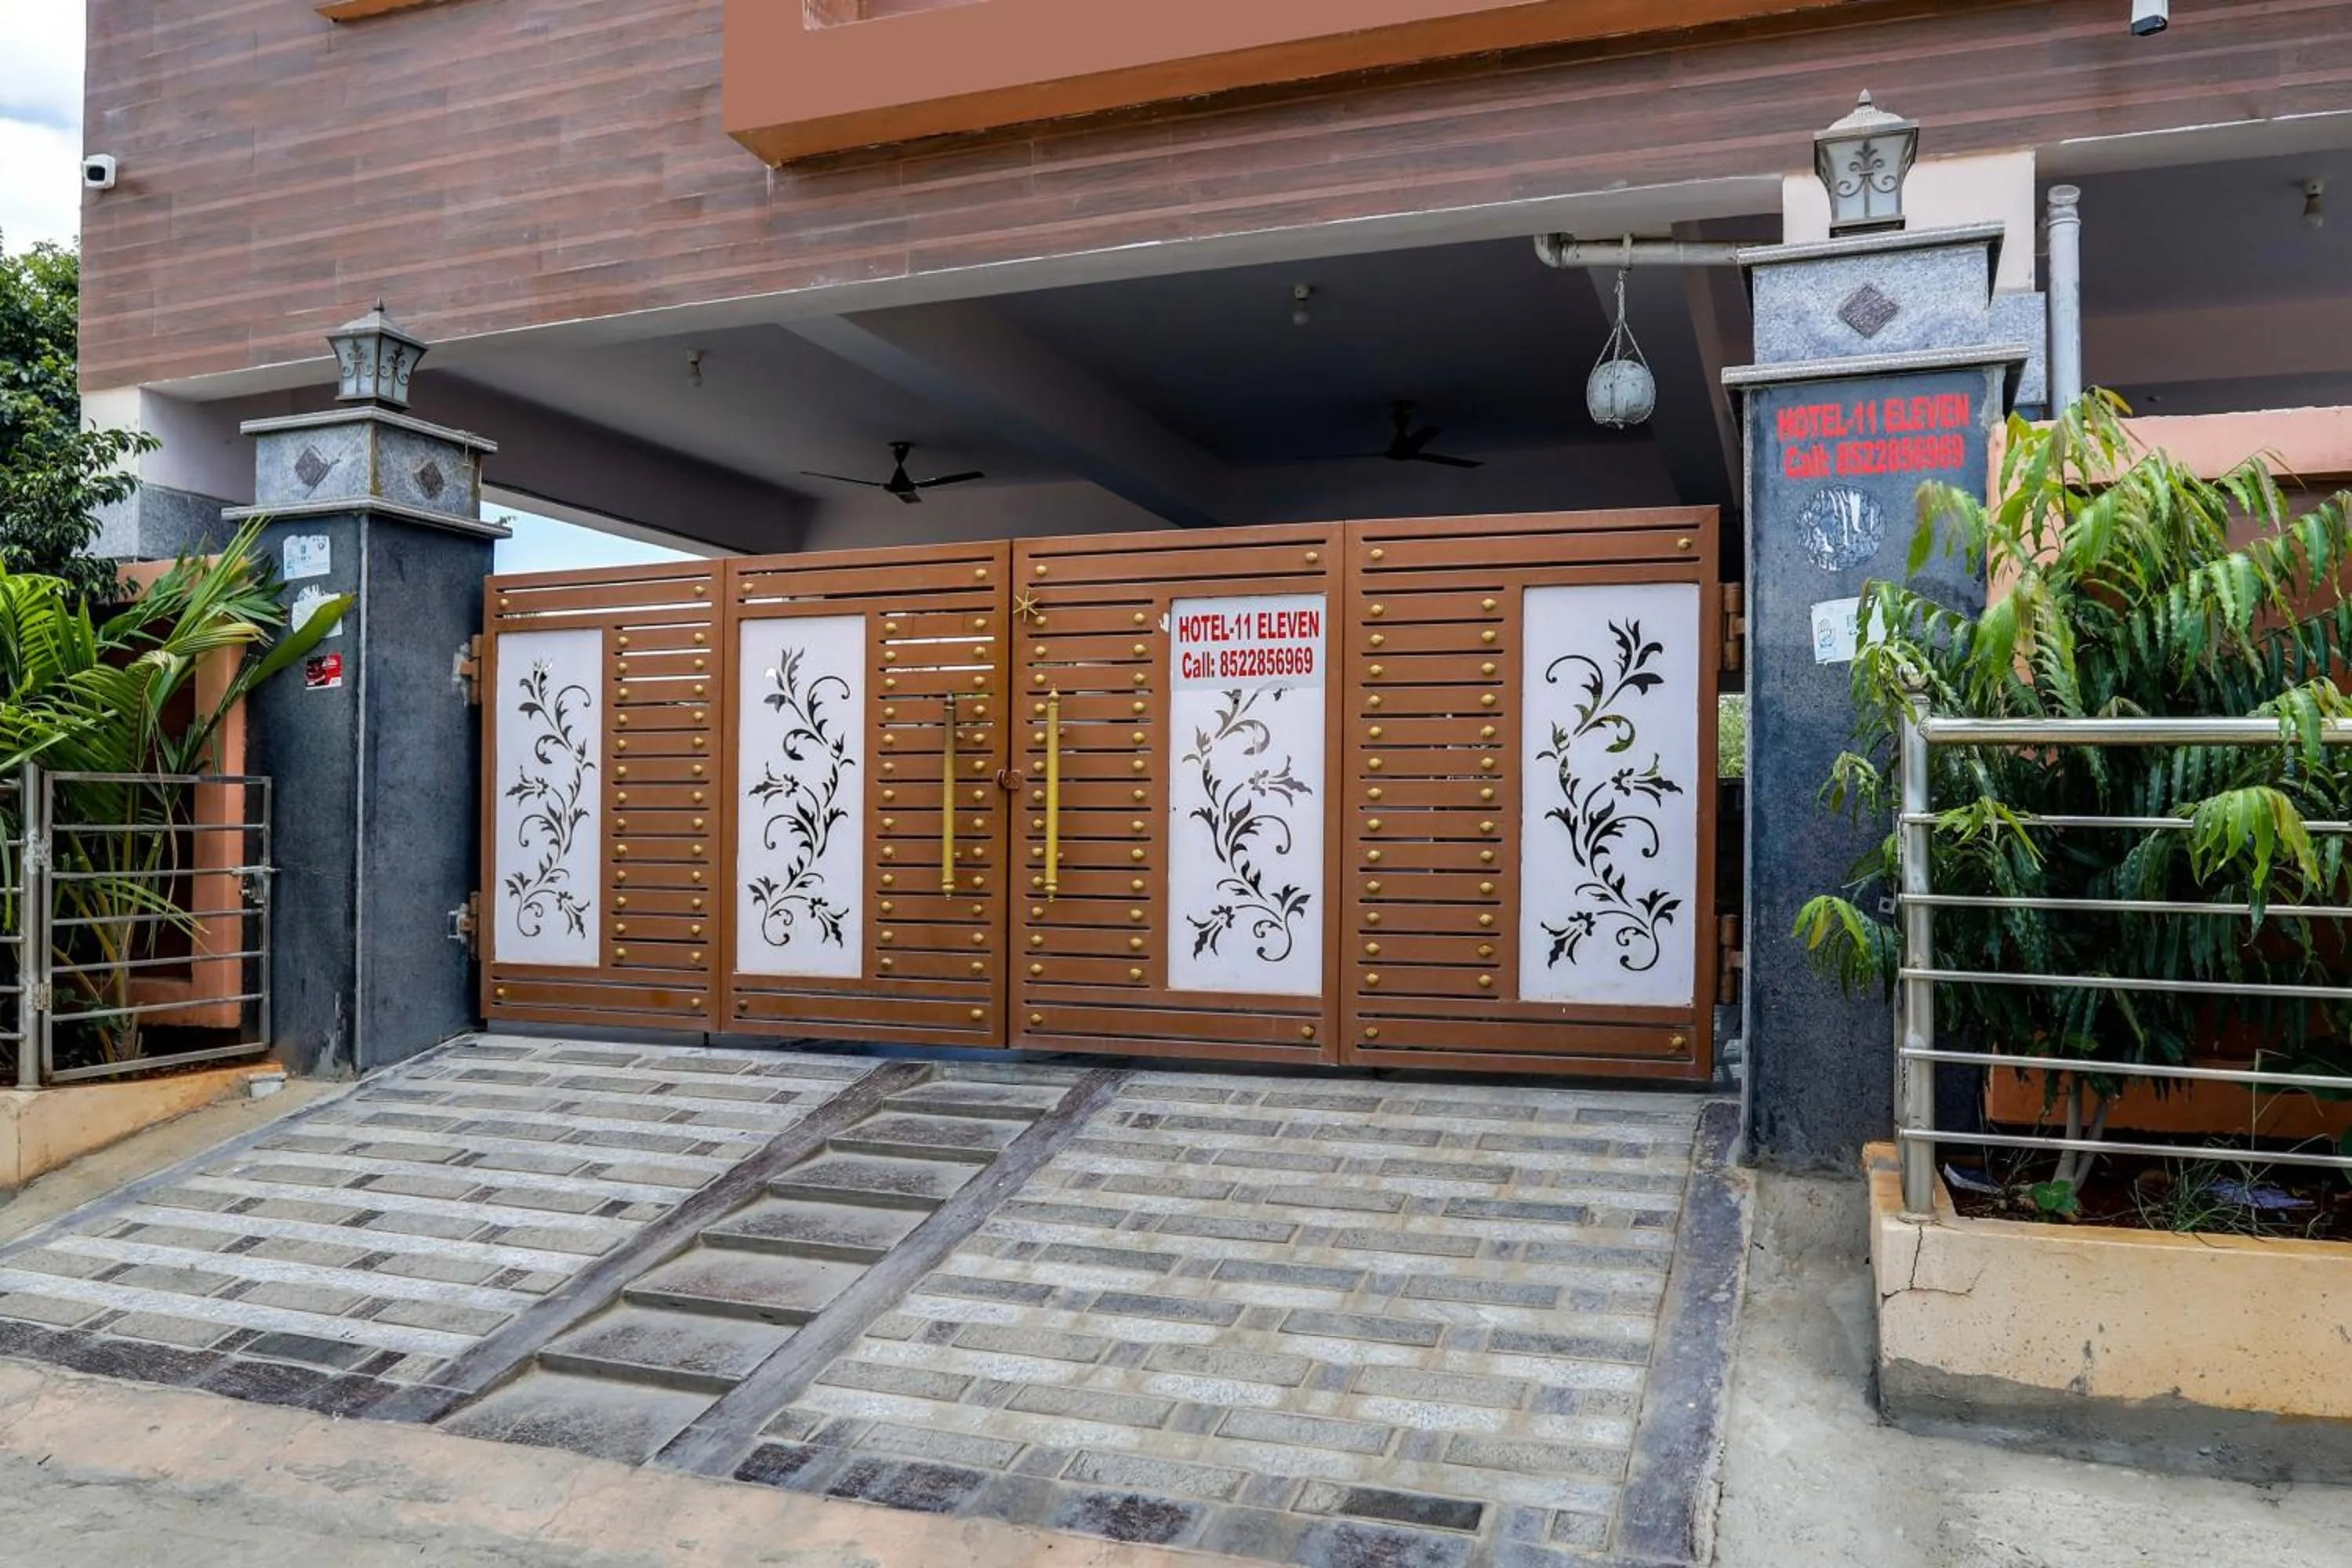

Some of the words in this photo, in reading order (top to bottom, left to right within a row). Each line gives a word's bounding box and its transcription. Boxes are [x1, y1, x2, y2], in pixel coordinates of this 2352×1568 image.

[1777, 401, 1876, 442] HOTEL-11
[1884, 394, 1970, 432] ELEVEN
[1179, 613, 1250, 642] HOTEL-11
[1258, 611, 1319, 639] ELEVEN
[1182, 652, 1214, 678] Call:
[1220, 647, 1313, 677] 8522856969
